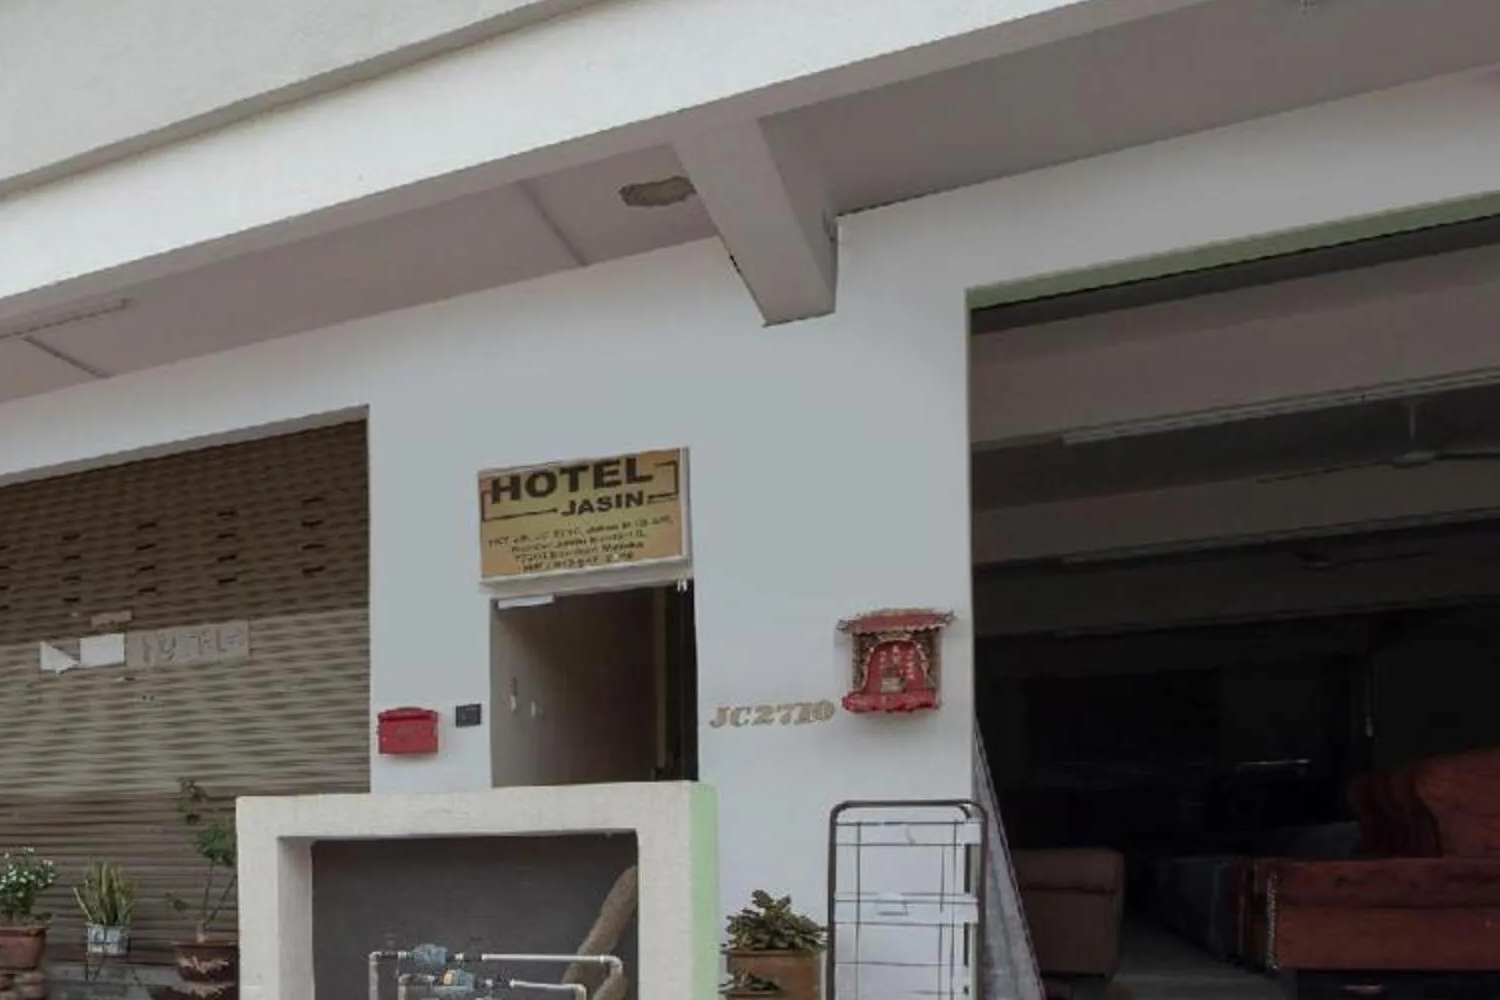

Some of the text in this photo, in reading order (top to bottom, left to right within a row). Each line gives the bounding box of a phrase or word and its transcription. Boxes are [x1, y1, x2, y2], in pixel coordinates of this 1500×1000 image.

[490, 457, 655, 504] HOTEL
[561, 490, 644, 517] JASIN
[708, 700, 835, 737] JC2710
